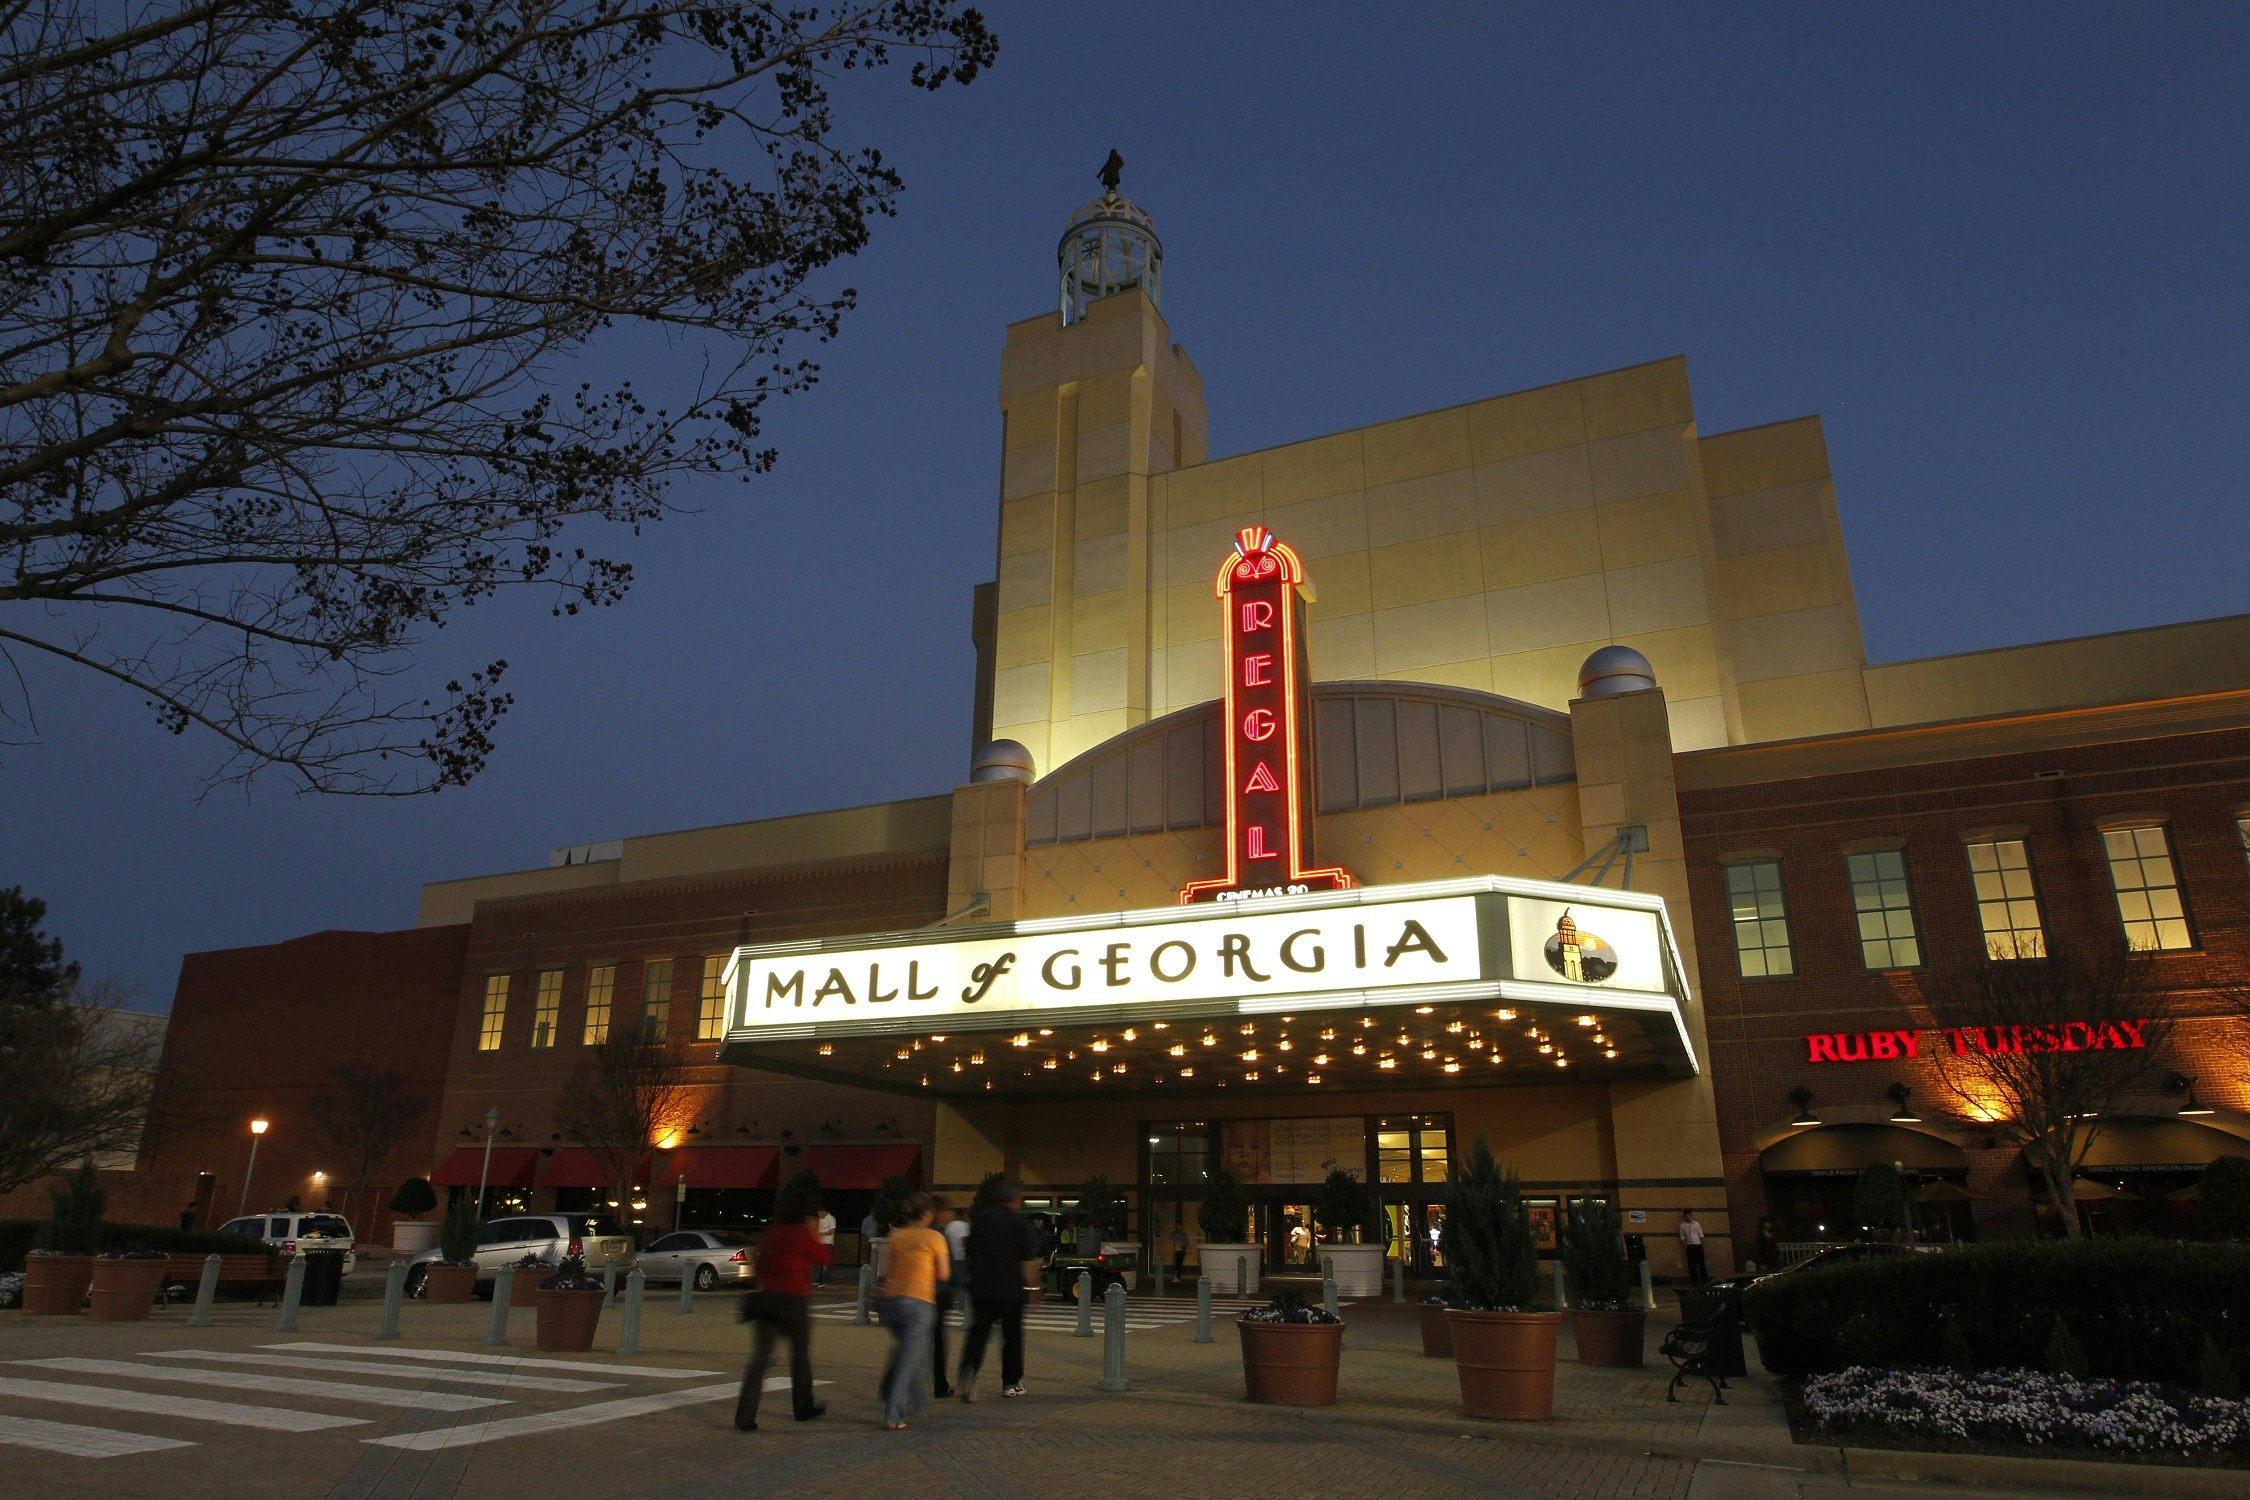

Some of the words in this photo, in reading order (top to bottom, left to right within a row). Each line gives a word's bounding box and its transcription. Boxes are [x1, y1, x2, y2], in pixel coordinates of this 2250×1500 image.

[1242, 601, 1279, 859] REGAL
[1216, 886, 1284, 902] CINEMAS
[1287, 884, 1309, 895] 20
[765, 959, 939, 1008] MALL
[961, 952, 1016, 1004] of
[1041, 919, 1449, 991] GEORGIA
[1806, 1029, 1924, 1063] RUBY
[1942, 1018, 2147, 1056] TUESDAY
